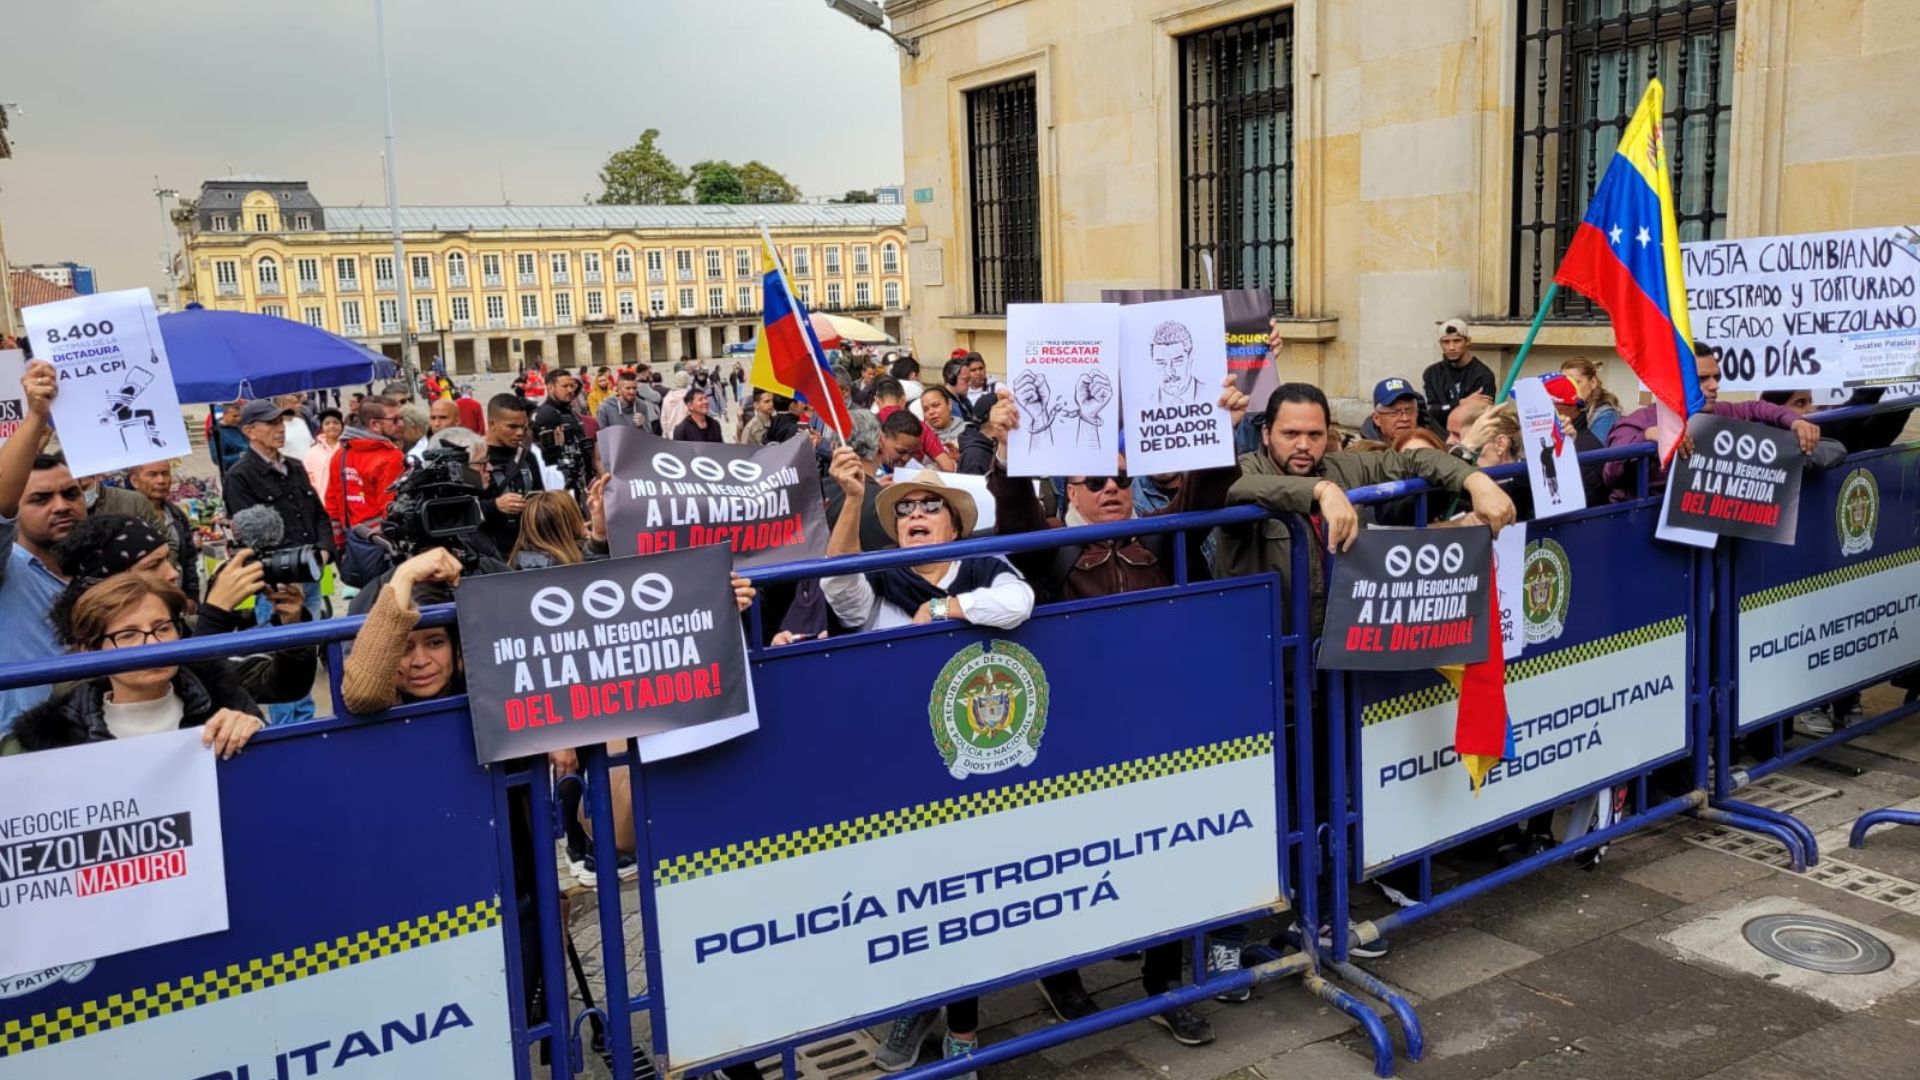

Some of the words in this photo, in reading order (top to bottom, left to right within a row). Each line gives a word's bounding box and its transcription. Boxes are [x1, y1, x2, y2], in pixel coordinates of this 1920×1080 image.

[1758, 236, 1893, 273] COLOMBIANO
[1809, 275, 1916, 302] TORTURADO
[46, 319, 114, 344] 8.400
[1706, 314, 1774, 340] ESTADO
[1783, 304, 1917, 336] VENEZOLANO
[53, 345, 122, 363] DICTADURA
[1025, 346, 1039, 356] ES
[1042, 346, 1100, 356] RESCATAR
[1025, 357, 1037, 365] LA
[1039, 356, 1100, 365] DEMOCRACIA
[1764, 339, 1822, 378] DÍAS
[60, 369, 72, 381] A
[75, 365, 97, 378] LA
[100, 359, 127, 373] CPI
[1139, 418, 1217, 438] VIOLADOR
[1140, 402, 1213, 423] MADURO
[1140, 438, 1163, 453] DE
[1165, 436, 1191, 449] DD.
[1193, 432, 1220, 447] HH.
[661, 482, 672, 496] A
[675, 482, 707, 496] UNA
[709, 466, 800, 498] NEGOCIACIÓN
[1691, 470, 1702, 491] A
[1704, 472, 1723, 494] LA
[1725, 476, 1775, 503] MEDIDA
[1706, 457, 1713, 471] A
[1715, 459, 1734, 474] UNA
[1734, 461, 1788, 484] NEGOCIACIÓN
[646, 498, 663, 528] A
[670, 496, 701, 526] LA
[708, 488, 790, 524] MEDIDA
[1681, 491, 1707, 515] DEL
[1708, 494, 1780, 527] DICTADOR!
[689, 513, 806, 553] DICTADOR!
[1379, 582, 1388, 598] A
[1391, 582, 1414, 598] UNA
[1416, 574, 1478, 597] NEGOCIACIÓN
[1358, 600, 1373, 624] A
[1379, 600, 1402, 624] LA
[1408, 595, 1467, 623] MEDIDA
[532, 636, 546, 657] A
[551, 629, 590, 653] UNA
[593, 609, 714, 647] NEGOCIACIÓN
[1345, 626, 1384, 652] DEL
[1390, 617, 1473, 652] DICTADOR!
[1749, 624, 1816, 663] POLICÍA
[1819, 594, 1920, 640] METROPOLIT
[1807, 649, 1831, 670] DE
[1833, 621, 1900, 662] BOGOTÁ
[514, 661, 535, 693] A
[542, 654, 581, 688] LA
[588, 635, 701, 681] MEDIDA
[983, 656, 996, 664] DE
[1005, 660, 1036, 707] COLOMBIA
[504, 693, 564, 732] DEL
[569, 662, 722, 720] DICTADOR!
[993, 721, 1032, 757] NACIONAL
[1507, 722, 1602, 778] BOGOTÁ
[994, 750, 1023, 769] PATRIA
[1380, 745, 1462, 788] POLIC
[86, 798, 140, 825] PARA
[0, 817, 185, 880] NEZOLANOS,
[16, 876, 73, 904] PANA
[77, 851, 184, 897] MADURO
[695, 891, 888, 964] POLICÍA
[897, 809, 1254, 914] METROPOLITANA
[868, 925, 930, 964] DE
[939, 870, 1120, 945] BOGOTÁ
[16, 966, 64, 990] PATRI
